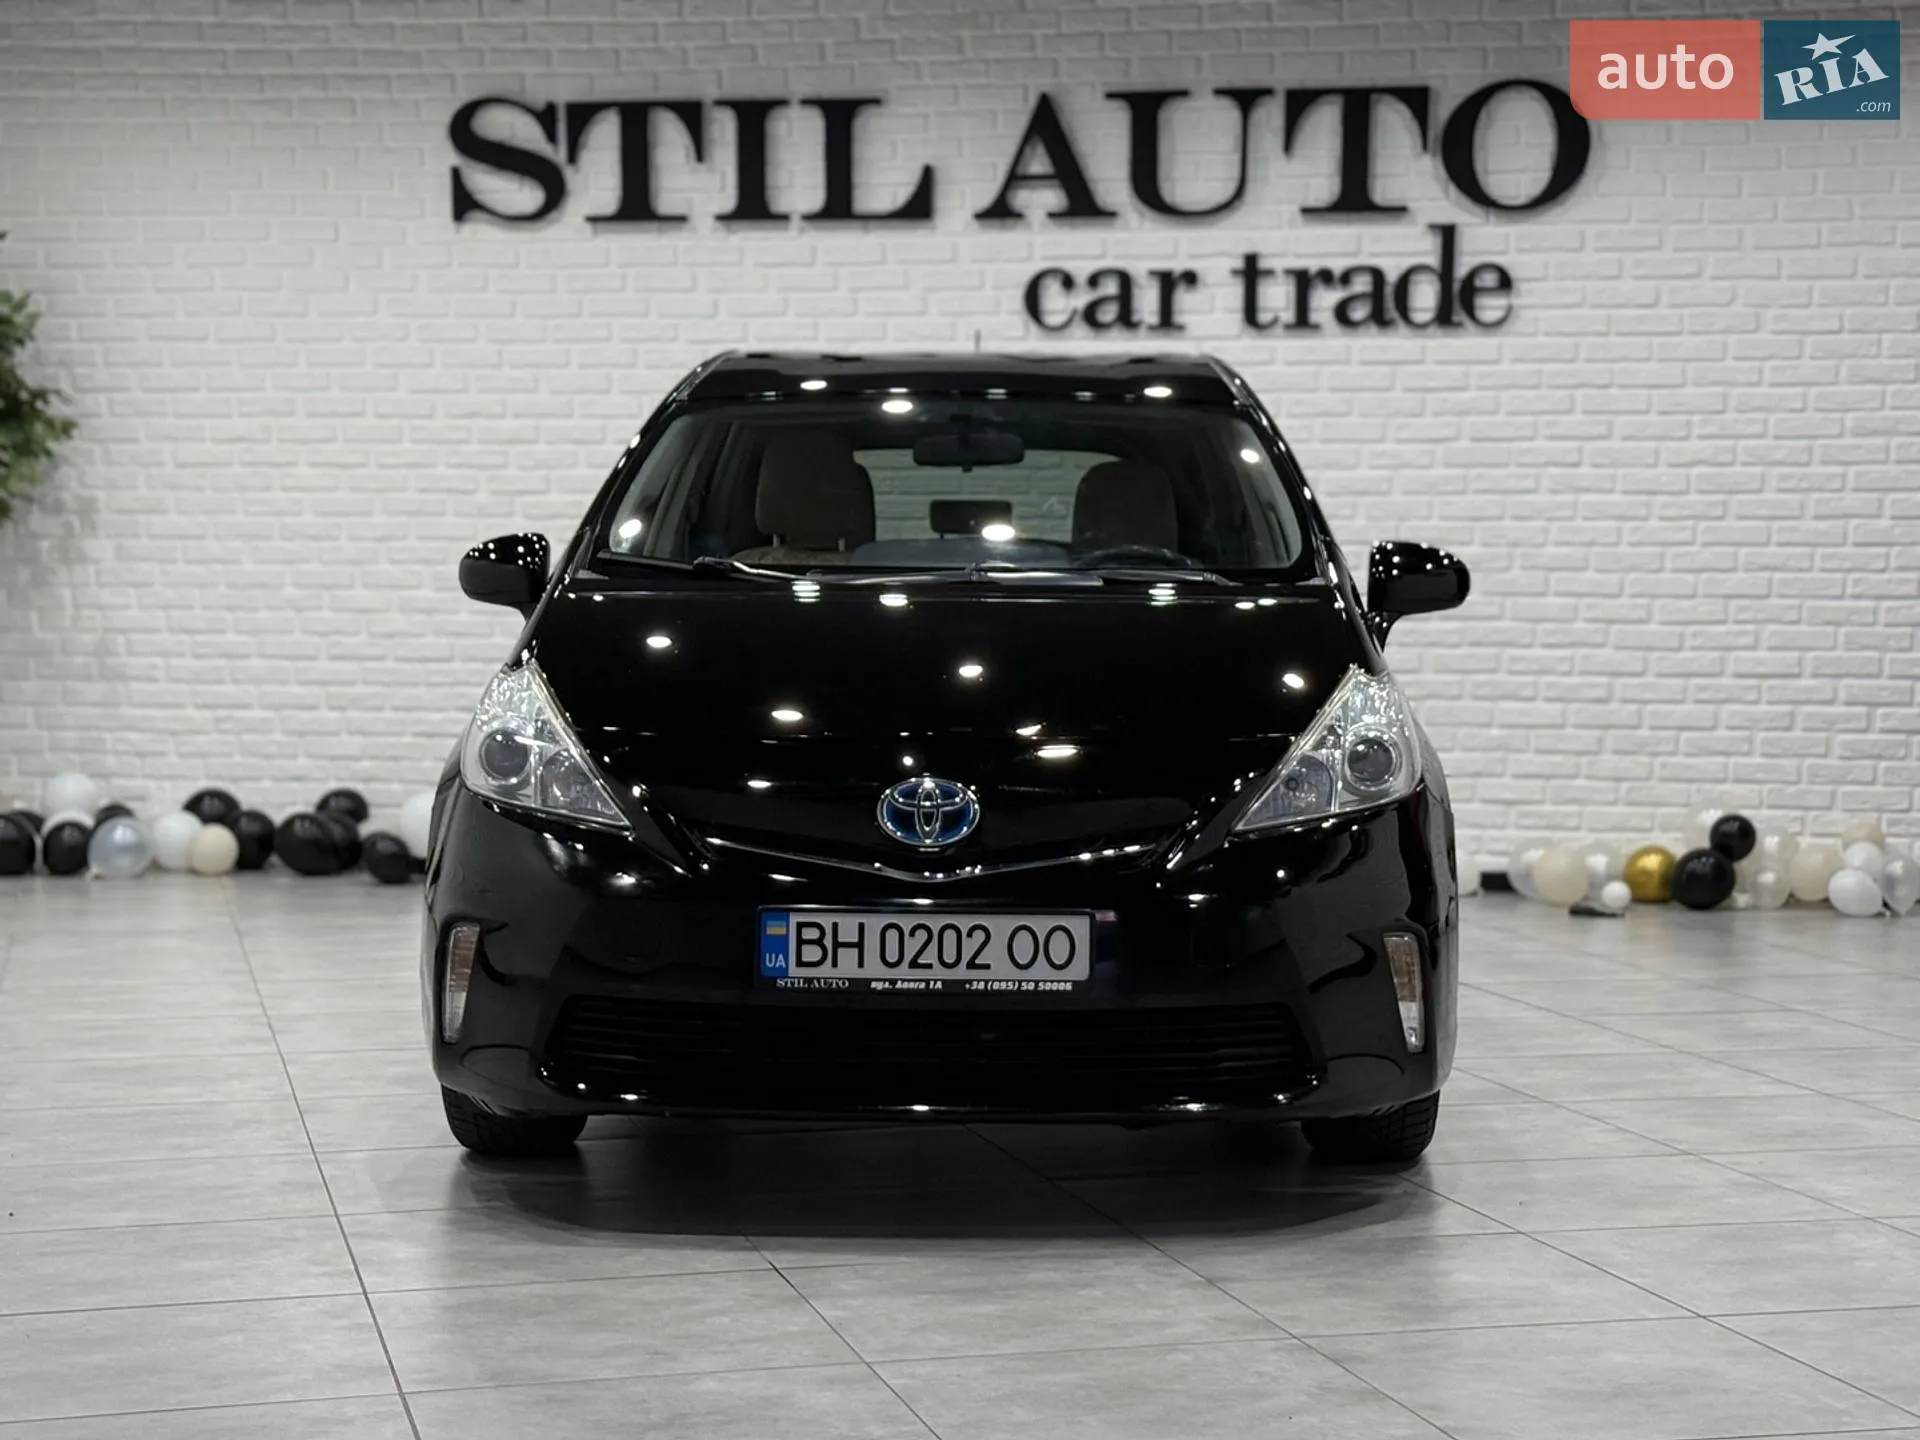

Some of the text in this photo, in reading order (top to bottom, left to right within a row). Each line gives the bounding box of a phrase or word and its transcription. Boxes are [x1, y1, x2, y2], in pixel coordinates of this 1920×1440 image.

[449, 79, 1592, 223] STIL AUTO
[1024, 224, 1515, 331] car trade
[765, 953, 787, 969] UA
[795, 920, 865, 969] BH
[879, 922, 992, 970] 0202
[776, 978, 849, 989] STIL AUTO
